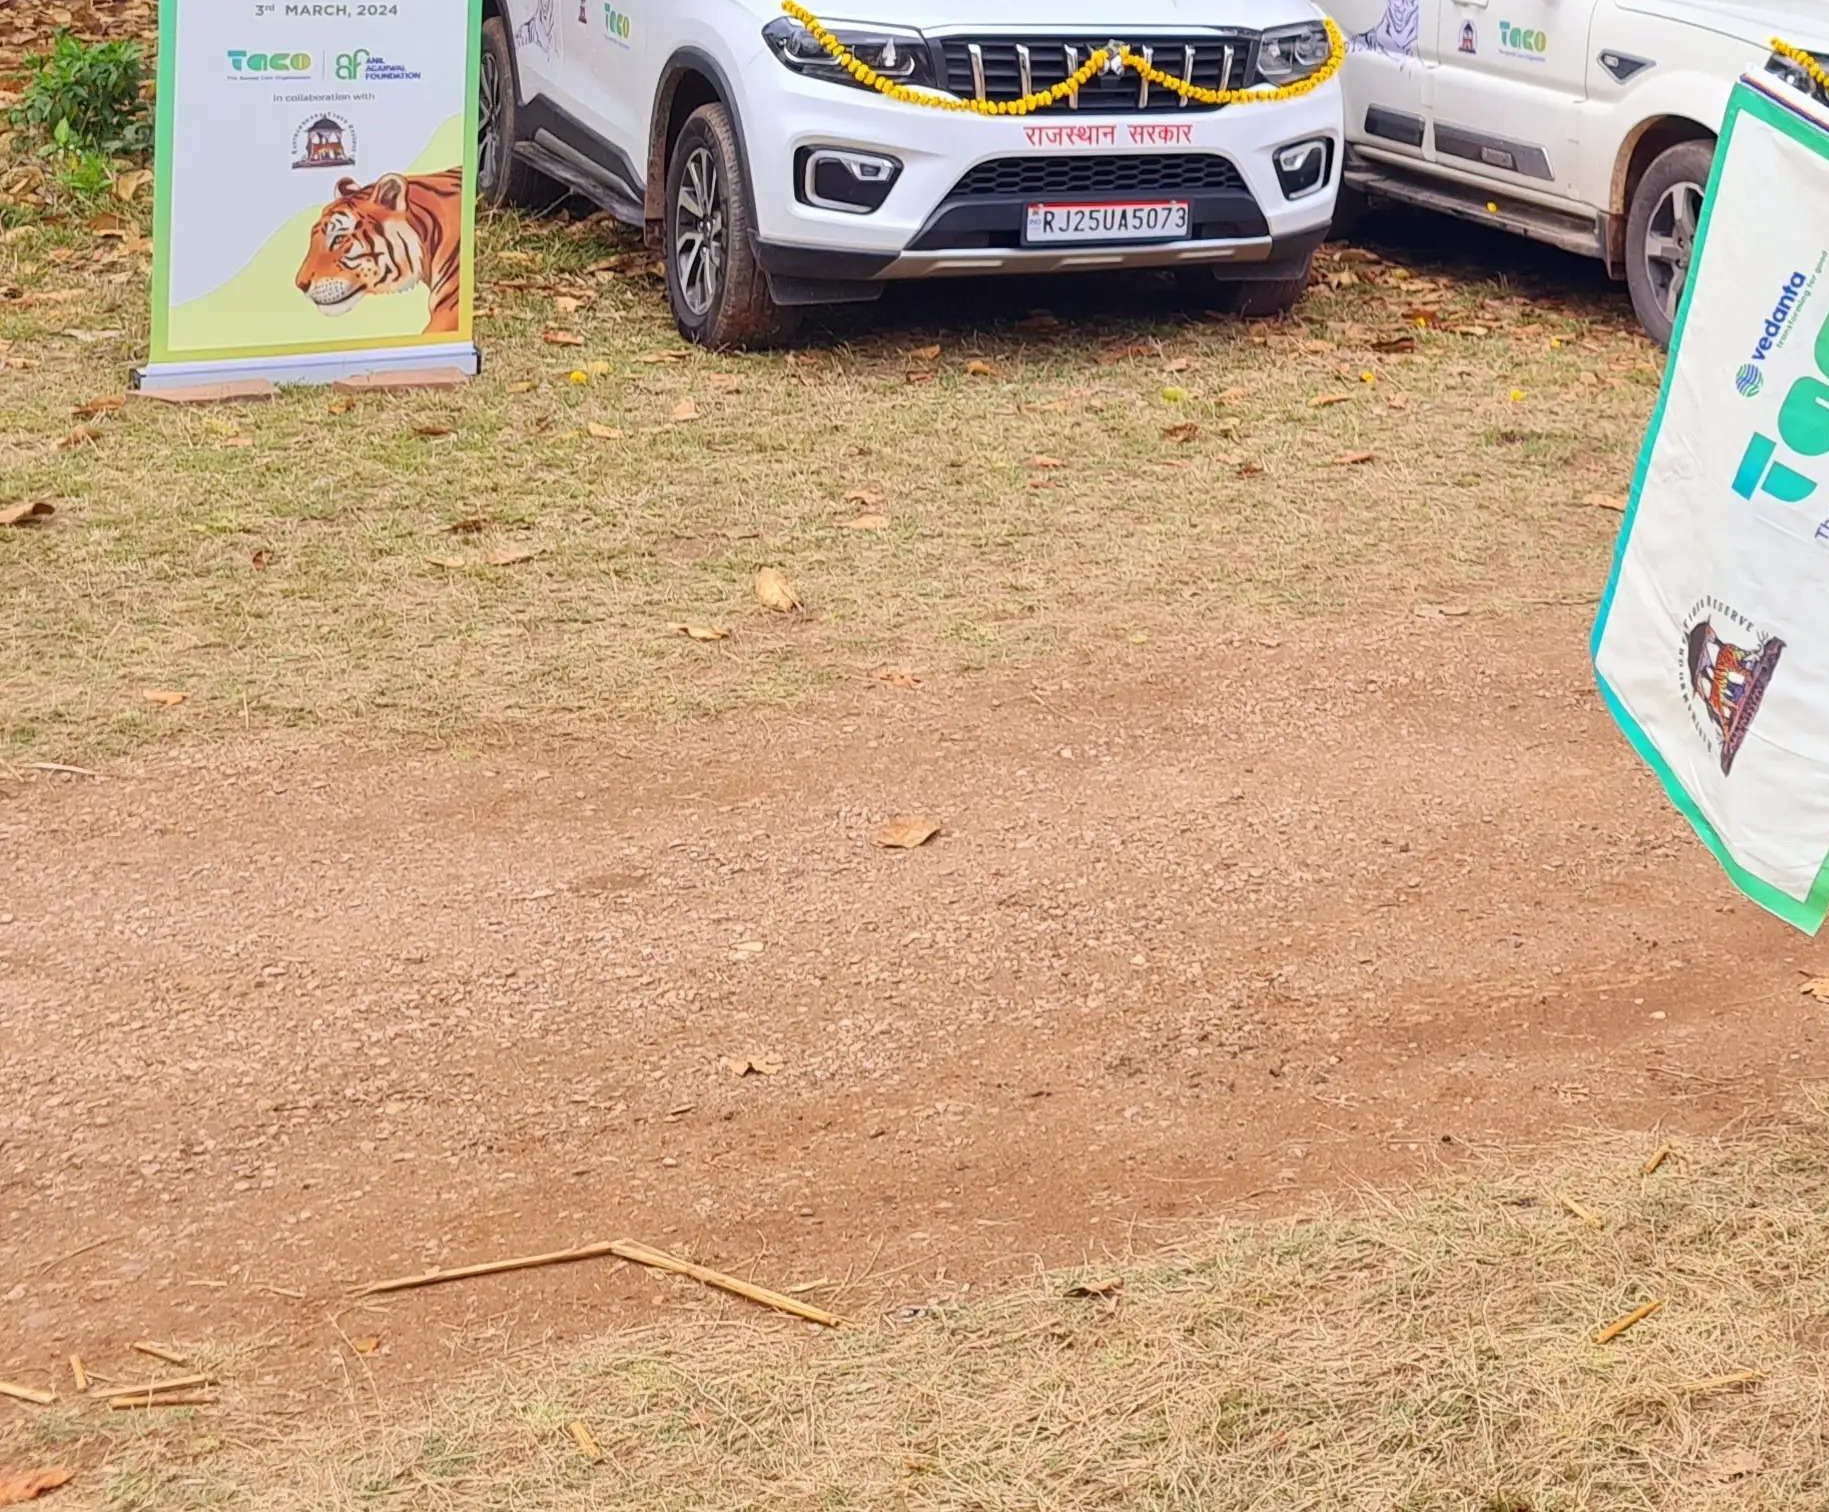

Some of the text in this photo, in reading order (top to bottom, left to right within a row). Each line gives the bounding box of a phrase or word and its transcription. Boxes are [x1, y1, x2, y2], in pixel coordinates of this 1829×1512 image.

[255, 4, 398, 18] 3rd MARCH, 2024
[365, 71, 421, 80] FOUNDATION
[273, 92, 375, 103] In collaboration with
[1023, 123, 1193, 146] राजस्थान सरकार
[1042, 207, 1187, 234] RJ25UA5073
[1776, 250, 1828, 349] transforming for good
[1751, 271, 1807, 362] vedanta
